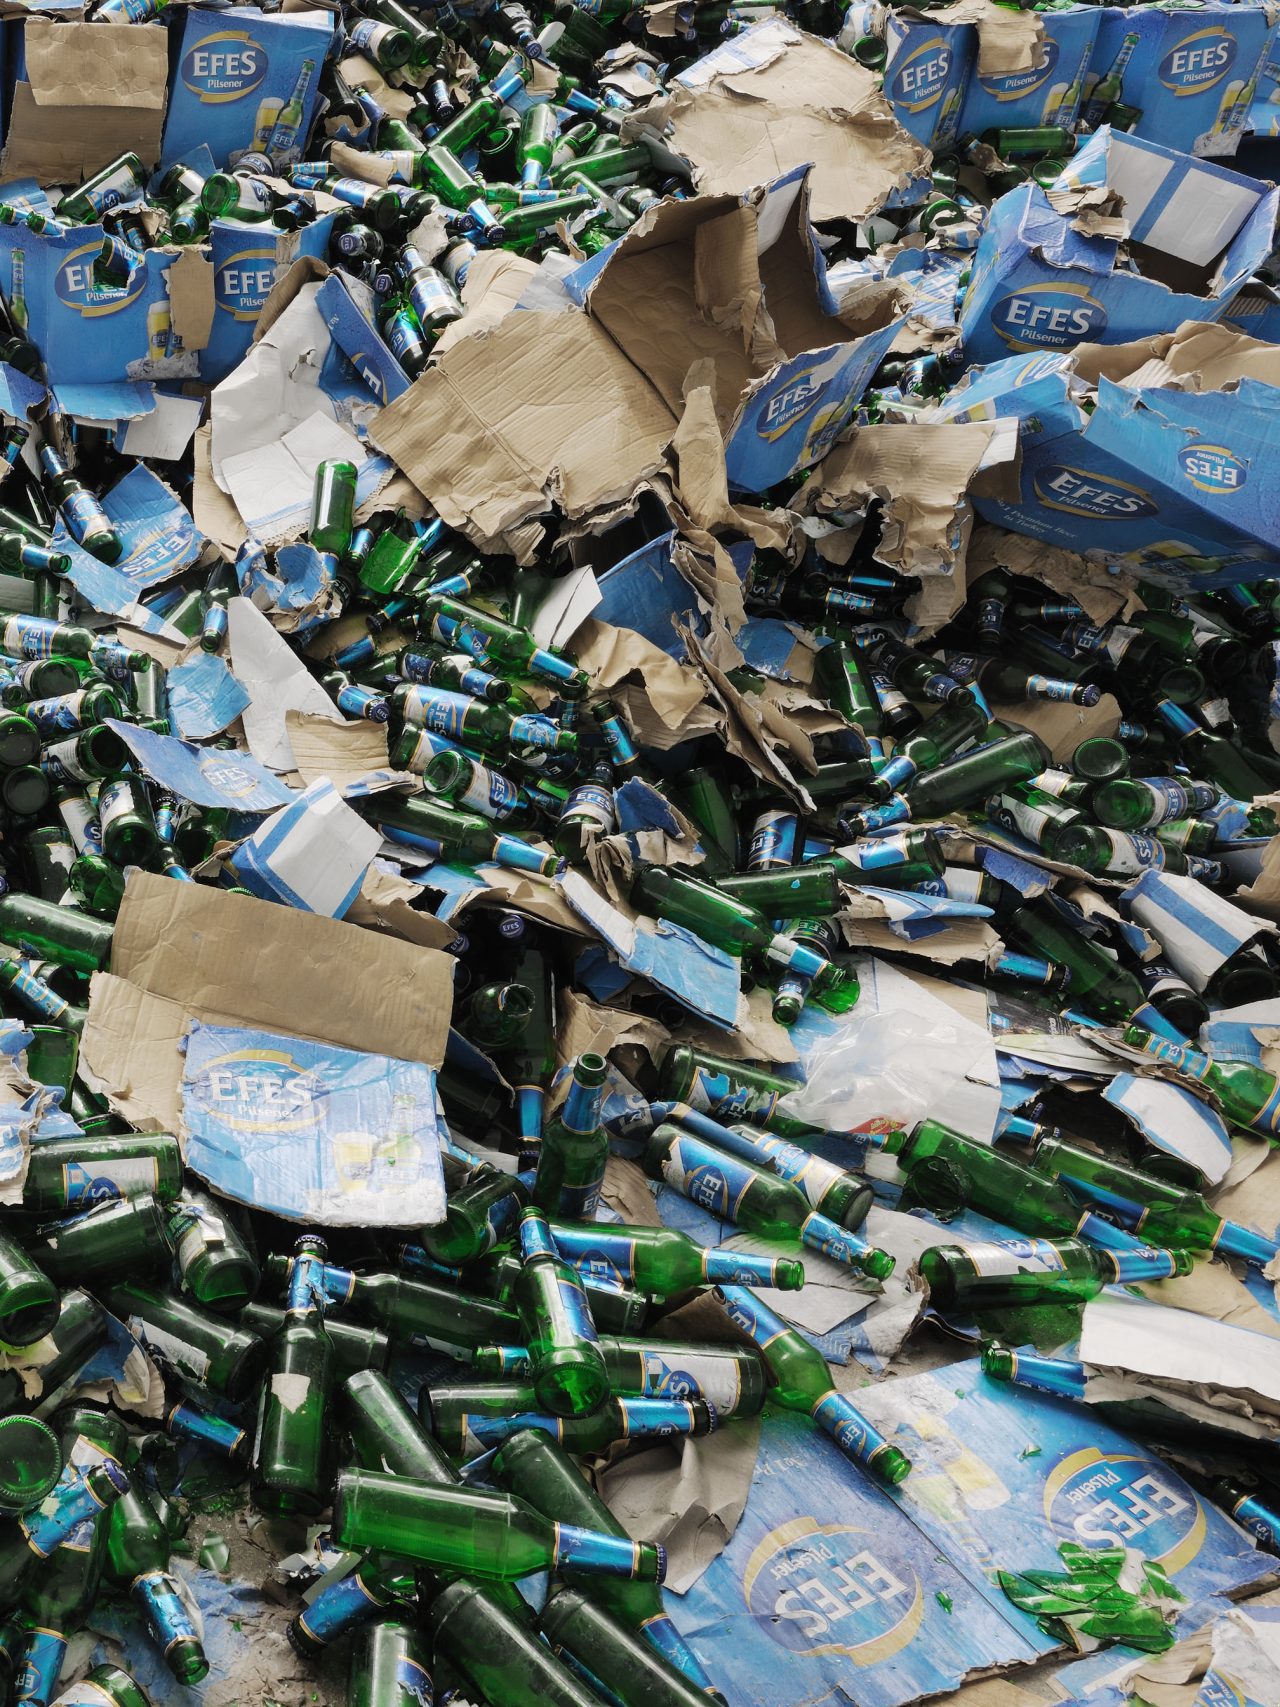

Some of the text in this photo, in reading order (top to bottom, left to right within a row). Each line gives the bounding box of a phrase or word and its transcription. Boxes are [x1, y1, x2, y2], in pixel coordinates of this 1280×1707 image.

[193, 51, 257, 77] EFES
[1171, 42, 1229, 74] EFES
[208, 78, 243, 89] Pilsener
[901, 53, 948, 93] EFES
[1005, 74, 1038, 89] Pilsener
[1183, 70, 1216, 83] Pilsener
[915, 82, 943, 99] Pilsener
[274, 133, 294, 146] EFES
[223, 271, 271, 295] EFE
[1006, 298, 1094, 335] EFES
[1020, 329, 1067, 345] Pilsener
[776, 402, 806, 424] Pilsener
[1196, 452, 1225, 462] Pilsener
[1186, 459, 1238, 486] EFES
[1050, 473, 1144, 513] EFES
[1058, 498, 1109, 515] Pilsener
[1013, 516, 1047, 536] Turkey
[123, 536, 186, 578] EFES
[575, 791, 612, 811] EFES
[450, 937, 463, 949] EFES
[209, 1071, 313, 1107] EFES
[1065, 1468, 1120, 1504] Pilsener
[1073, 1475, 1191, 1548] EFES
[771, 1541, 835, 1579] Pilsener
[775, 1551, 908, 1639] EFES
